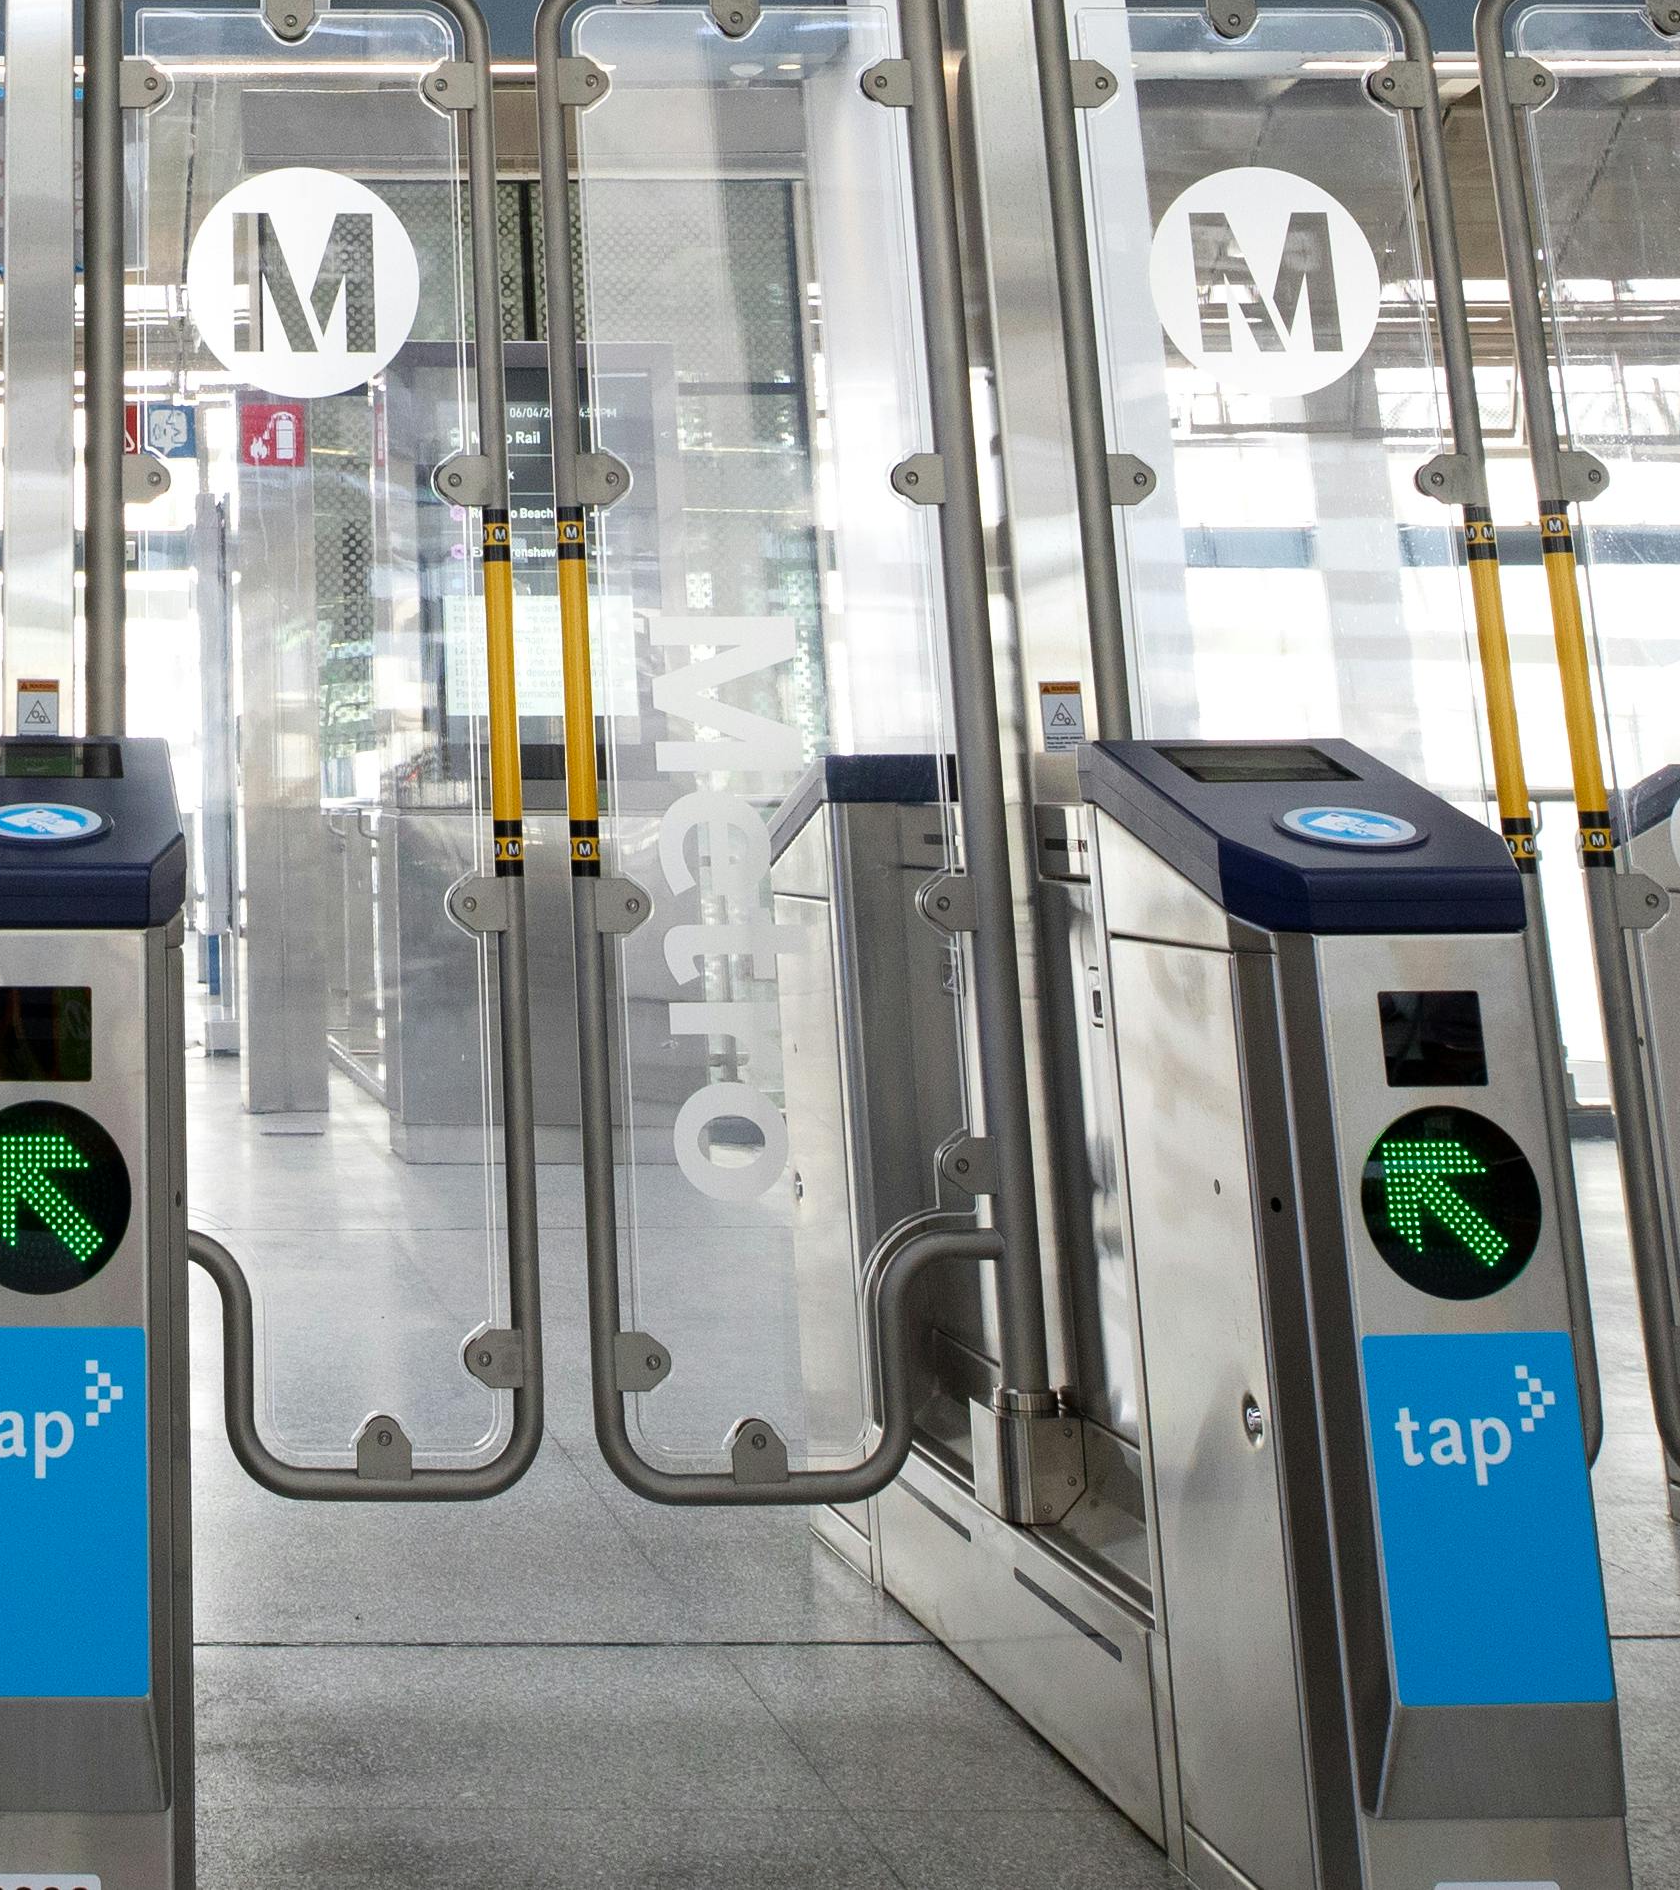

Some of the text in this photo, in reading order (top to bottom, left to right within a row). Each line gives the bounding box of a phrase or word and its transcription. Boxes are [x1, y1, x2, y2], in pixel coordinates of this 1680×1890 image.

[515, 431, 541, 444] Rail
[519, 508, 554, 519] Beach
[650, 615, 804, 1202] Metro
[1395, 1407, 1514, 1487] tap
